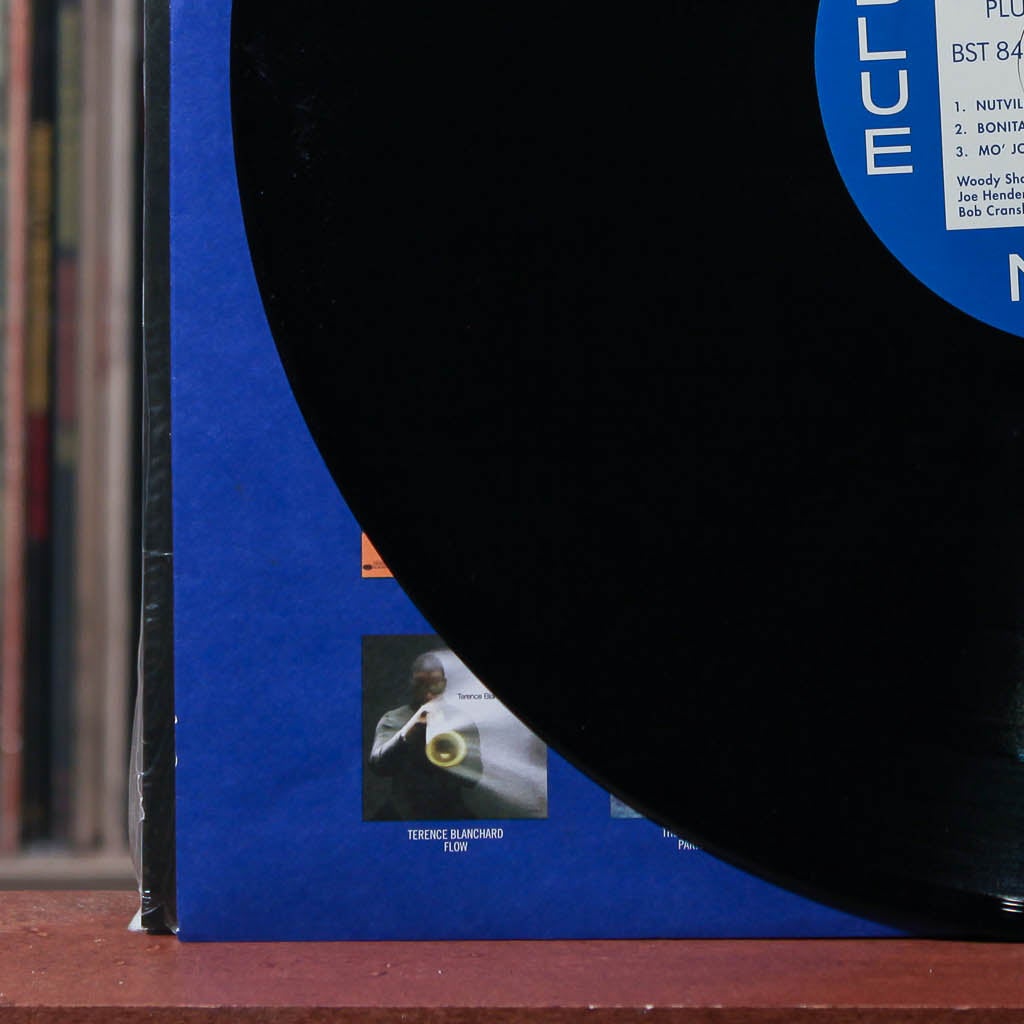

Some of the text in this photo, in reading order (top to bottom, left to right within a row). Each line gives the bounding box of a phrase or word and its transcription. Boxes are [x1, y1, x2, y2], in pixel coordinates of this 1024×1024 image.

[952, 42, 989, 63] BST
[954, 101, 966, 113] 1.
[955, 123, 967, 135] 2.
[956, 146, 968, 158] 3.
[957, 175, 1001, 190] Woody
[957, 191, 978, 203] Joe
[959, 206, 982, 218] Bob
[408, 829, 503, 840] TERENCE BLANCHARD
[444, 842, 468, 852] FLOW
